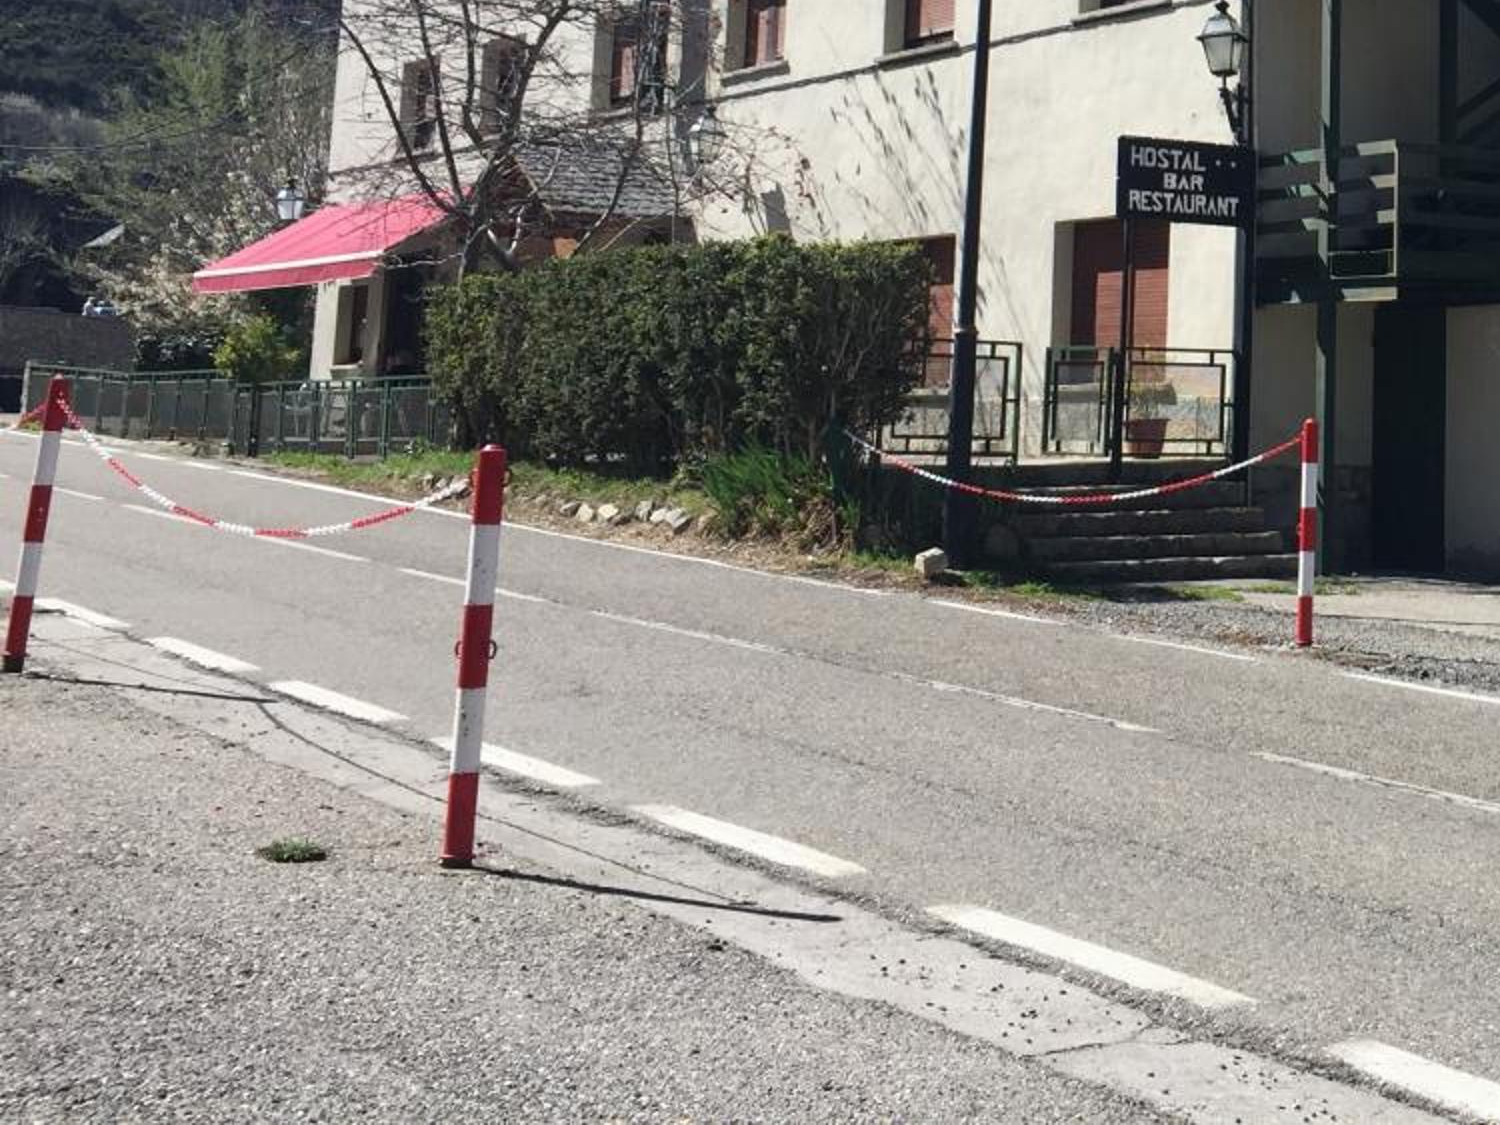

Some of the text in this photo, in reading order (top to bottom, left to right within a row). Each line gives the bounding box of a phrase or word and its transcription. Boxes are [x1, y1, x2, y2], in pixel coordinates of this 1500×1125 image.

[1130, 144, 1206, 172] HOSTAL
[1163, 172, 1204, 192] BAR
[1128, 189, 1239, 217] RESTAURANT
